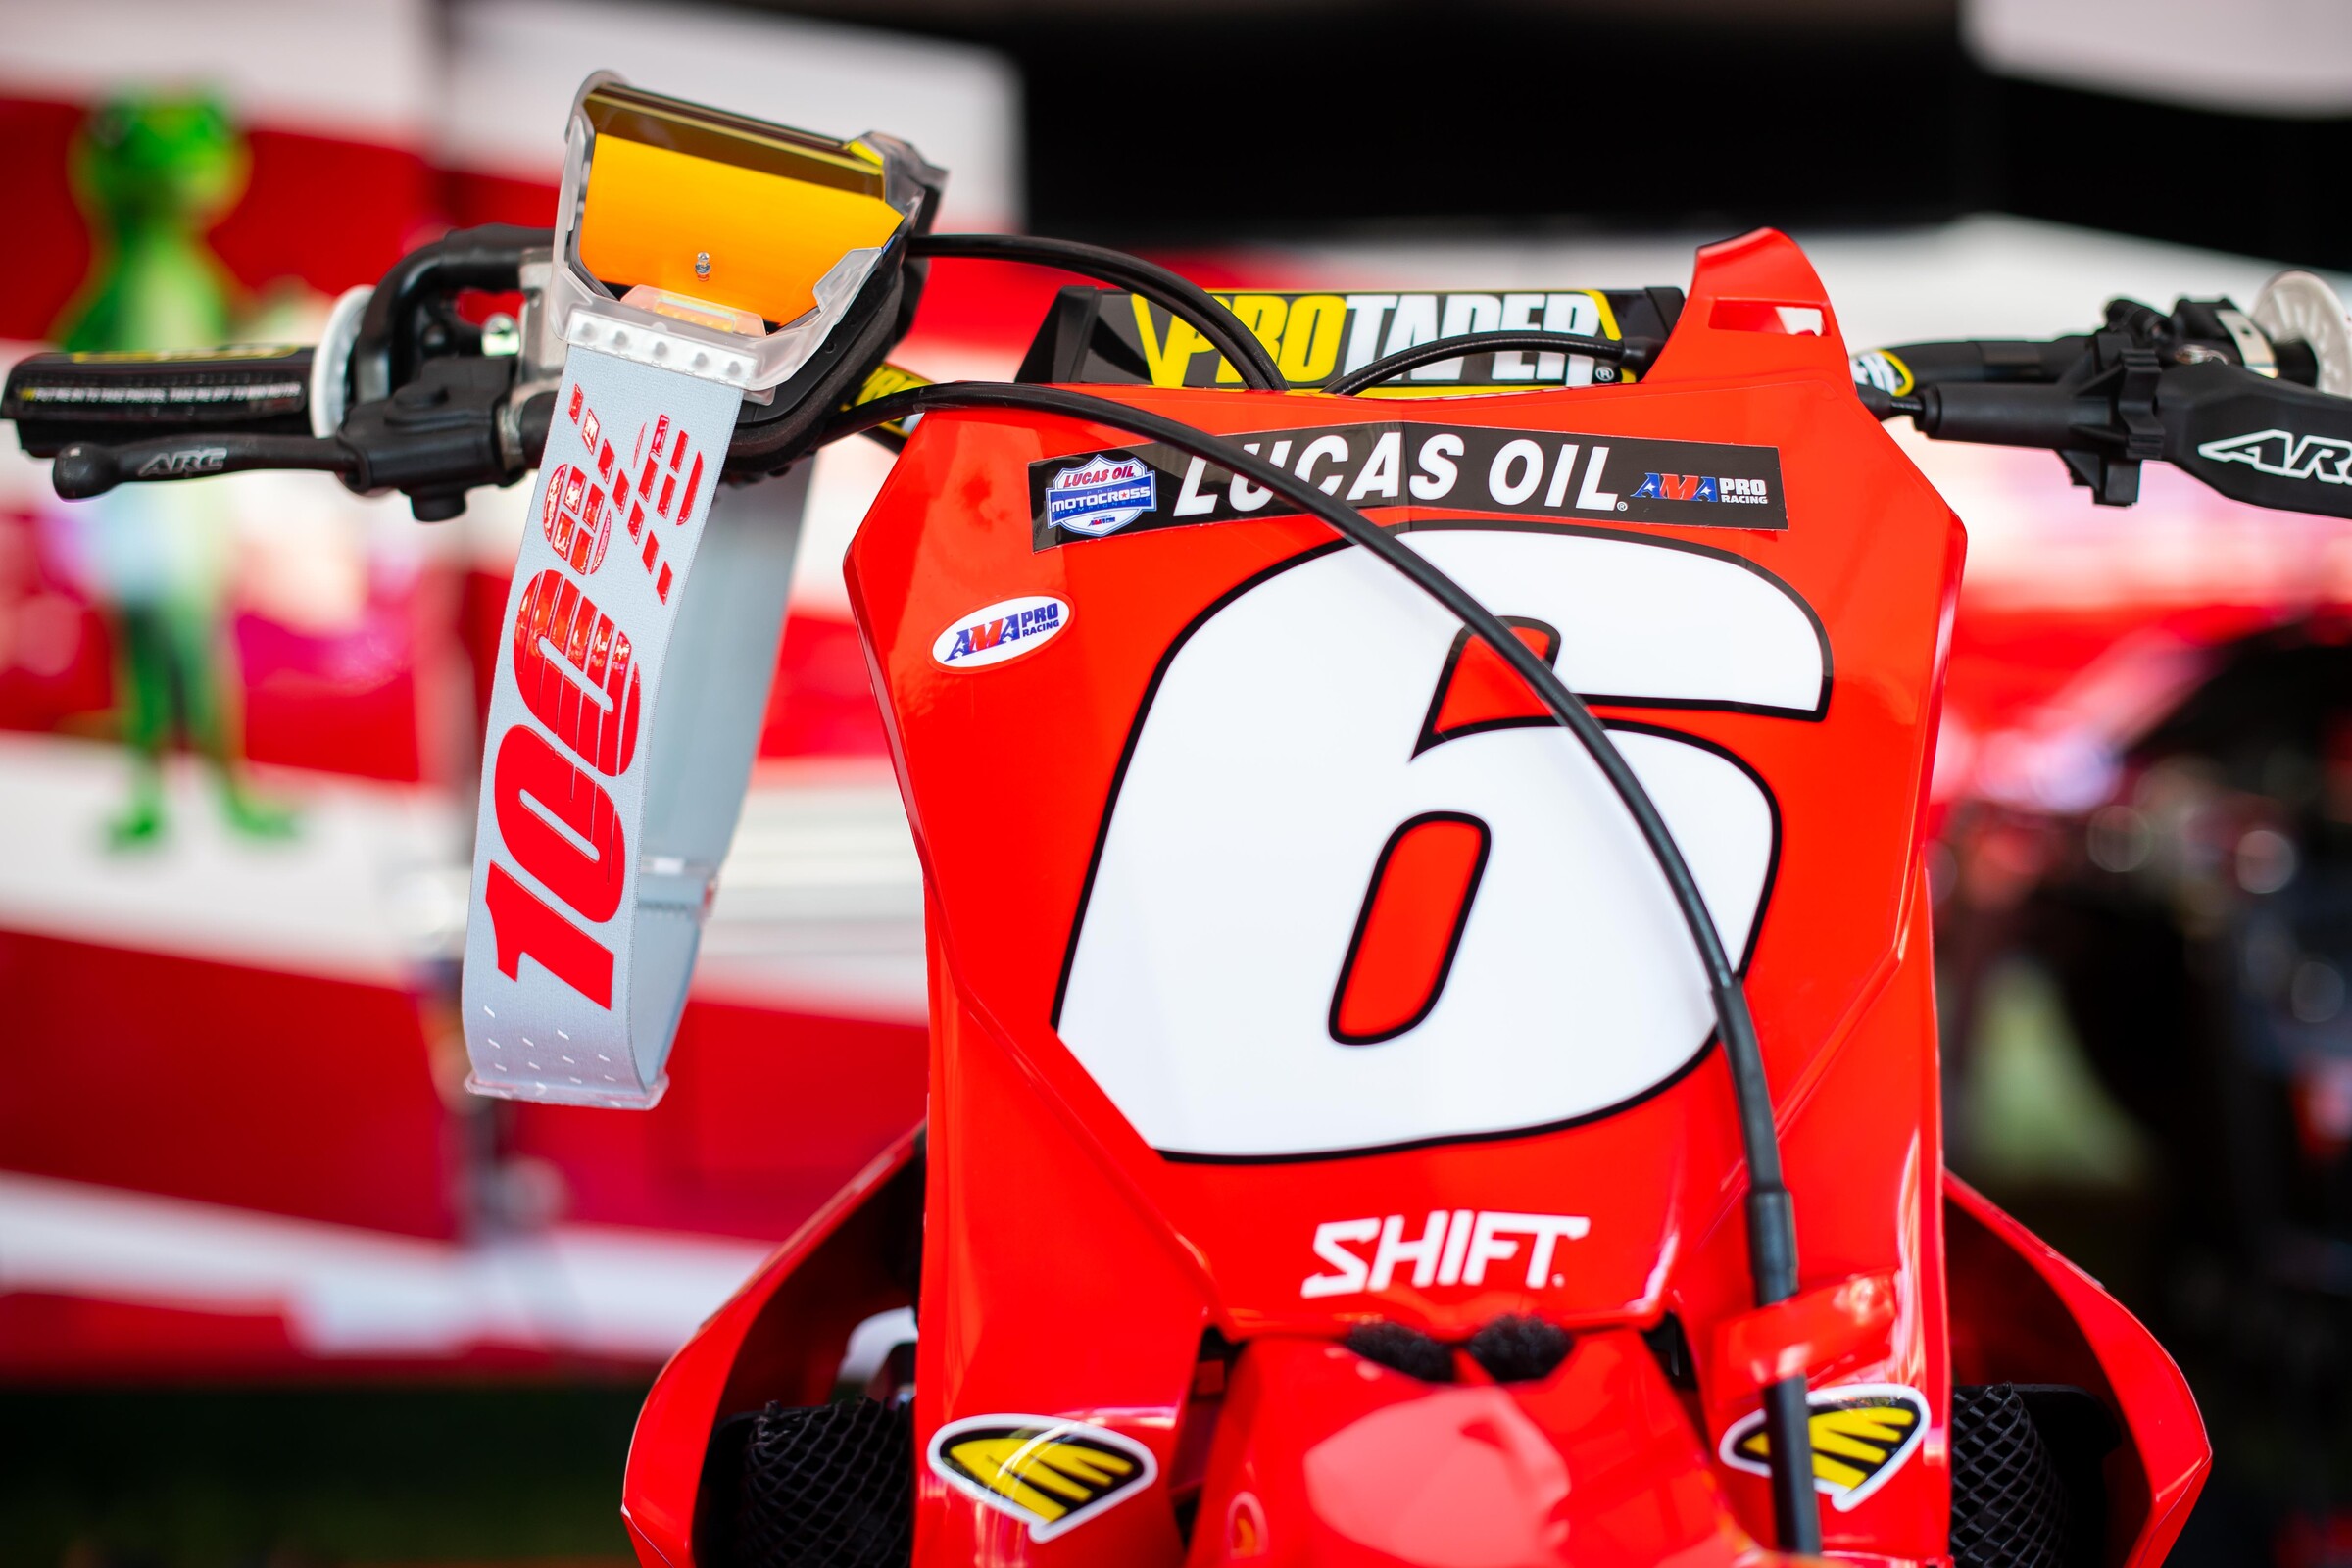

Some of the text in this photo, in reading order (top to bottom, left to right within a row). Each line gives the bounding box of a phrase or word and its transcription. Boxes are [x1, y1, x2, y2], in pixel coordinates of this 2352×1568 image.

[138, 447, 227, 477] ARC
[1063, 466, 1136, 488] LUCAS OIL
[1174, 431, 1465, 517] LUCAS
[2197, 429, 2352, 486] AR
[1052, 486, 1151, 513] MOTOCROSS
[1630, 472, 1767, 502] AMA PRO
[1721, 495, 1769, 505] RACING
[943, 602, 1059, 662] AMA PRO
[1022, 619, 1060, 637] RACING
[486, 383, 704, 1011] 100%
[1050, 520, 1834, 1165] 6
[1300, 1209, 1592, 1299] SHIFT
